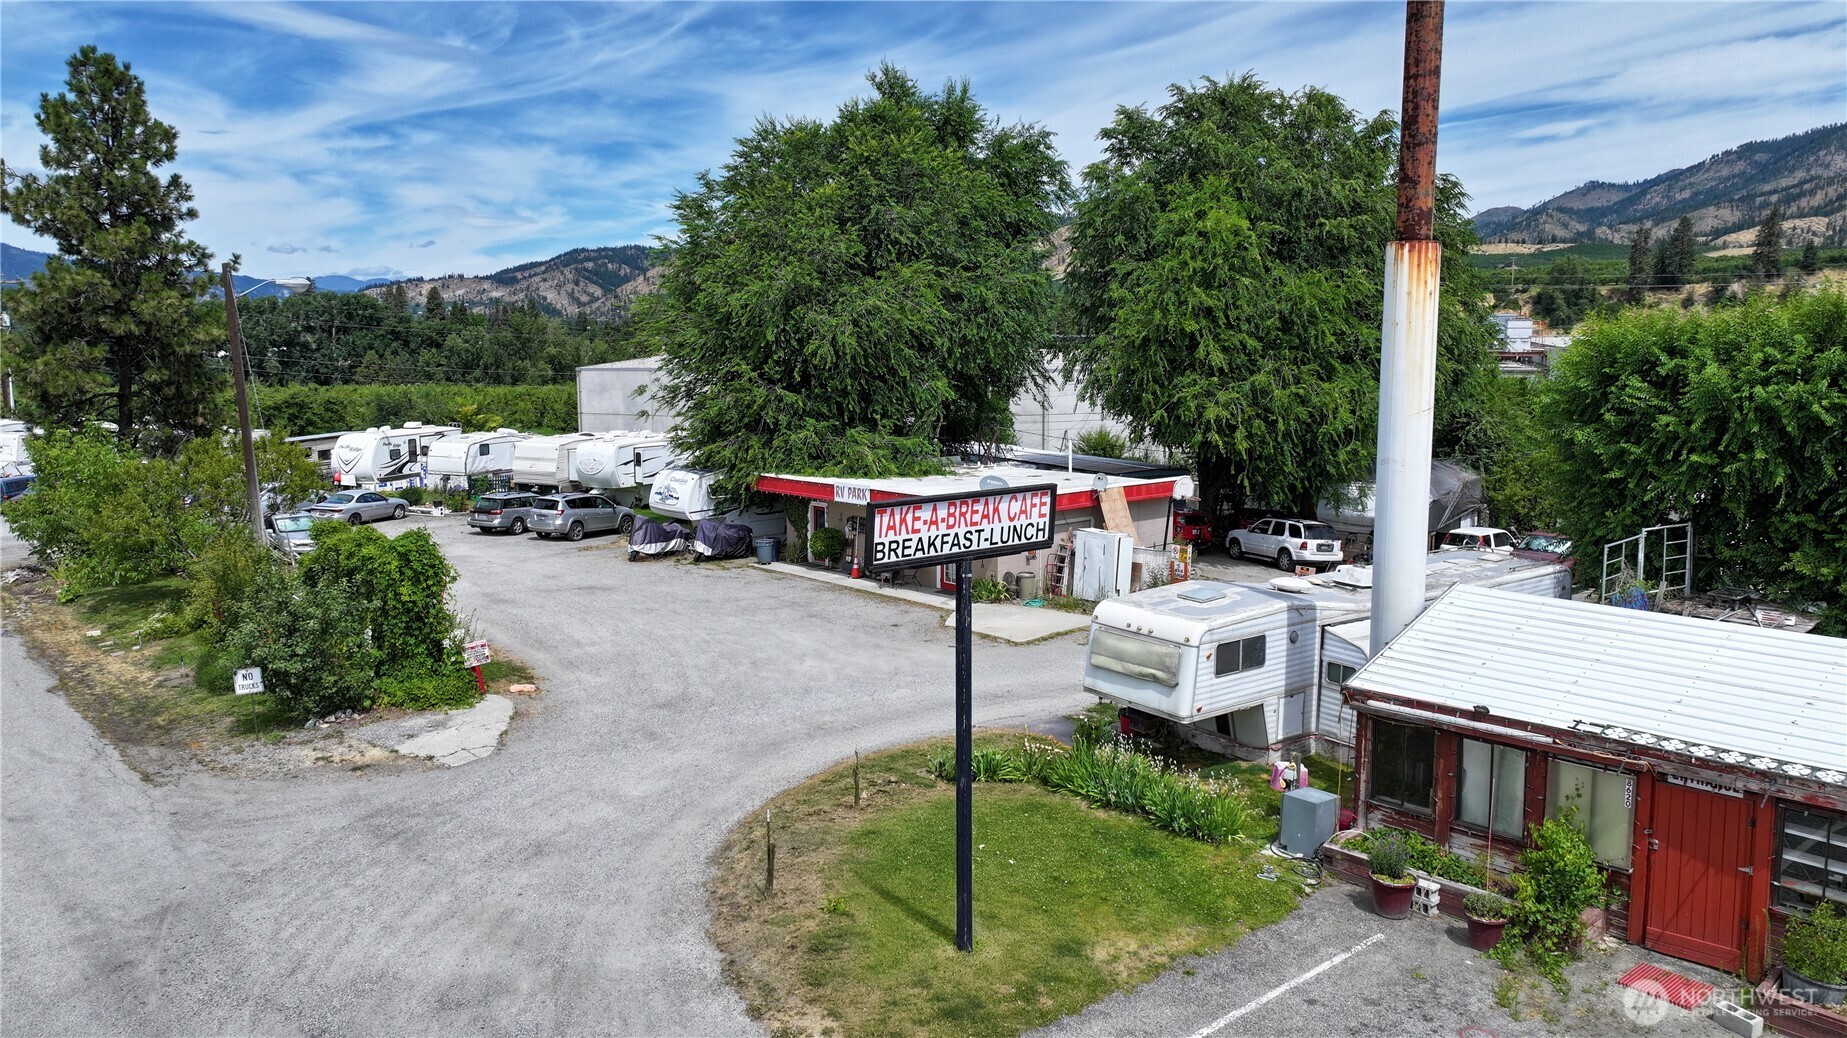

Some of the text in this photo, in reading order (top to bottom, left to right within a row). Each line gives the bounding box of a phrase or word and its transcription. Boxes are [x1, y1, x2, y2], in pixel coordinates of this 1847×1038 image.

[835, 485, 867, 501] RV PARK
[876, 491, 1049, 539] TAKE-A-BREAK CAFE
[873, 521, 1047, 562] BREAKFAST-LUNCH
[242, 672, 254, 681] NO
[238, 682, 260, 690] TRUCKS
